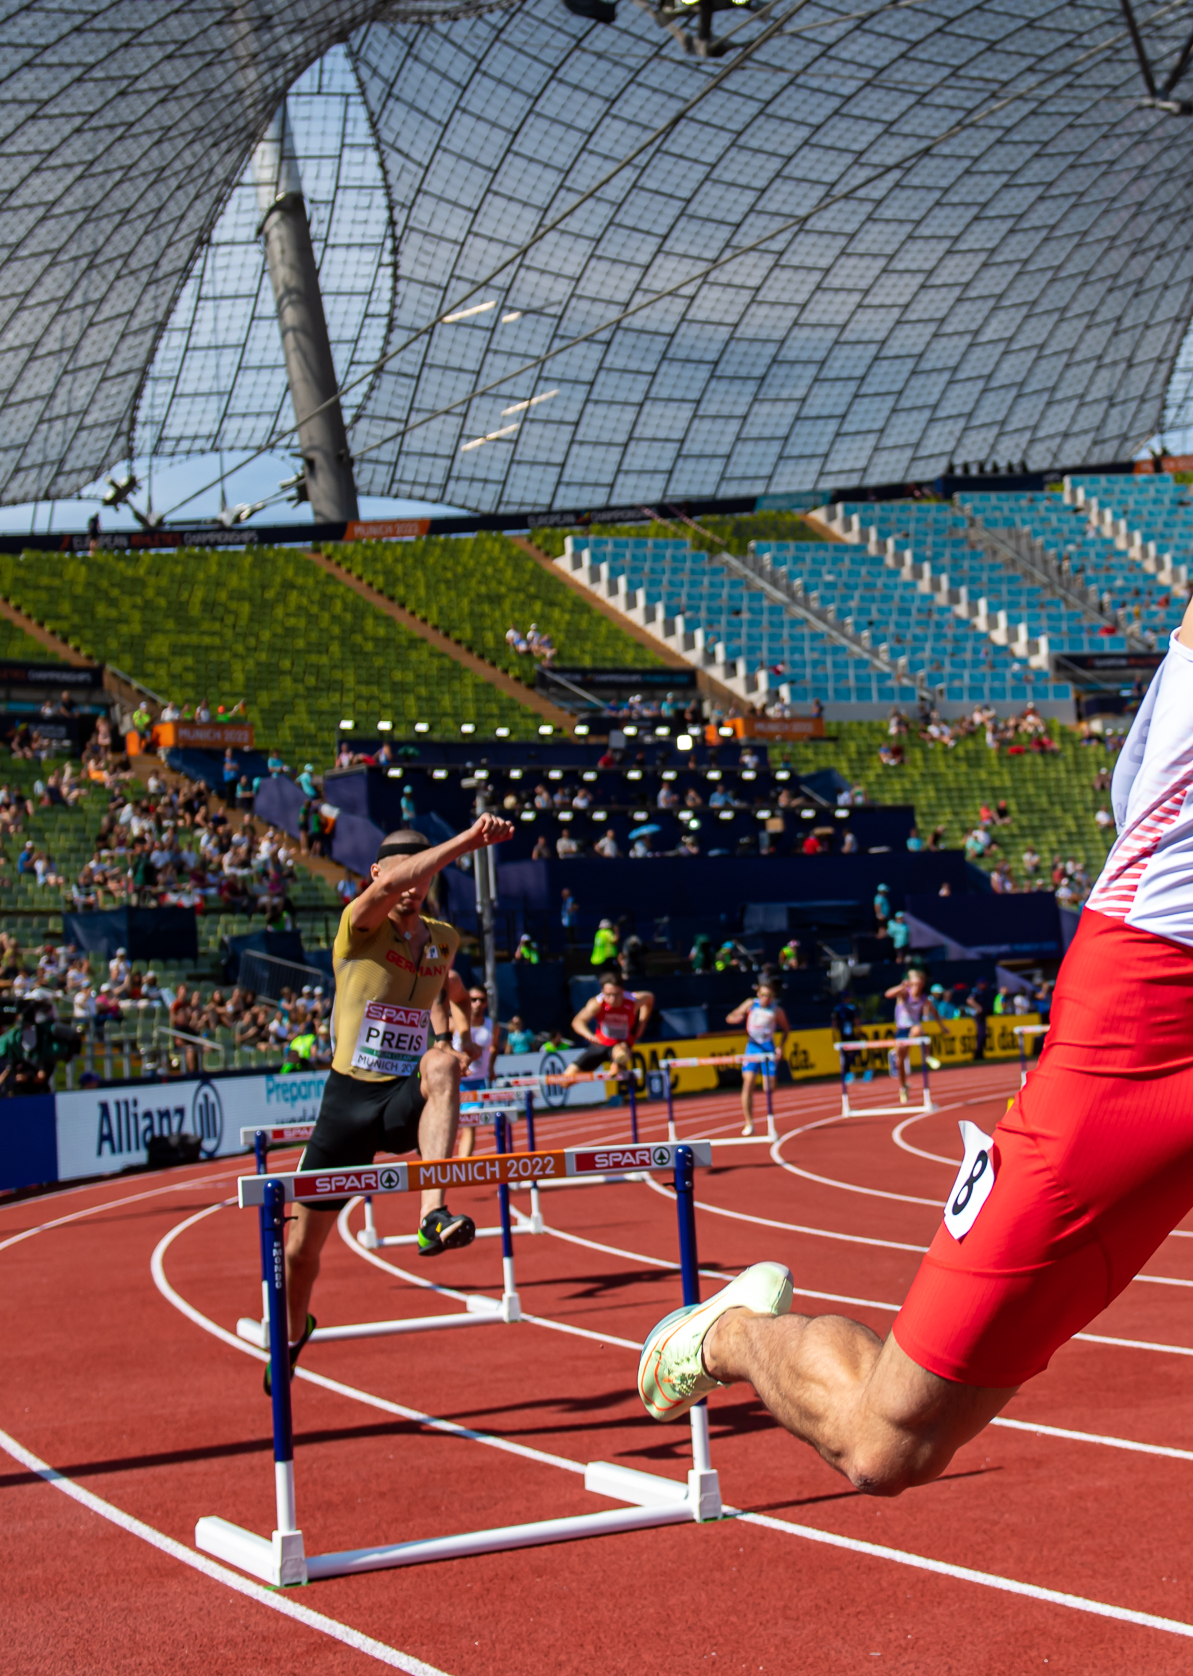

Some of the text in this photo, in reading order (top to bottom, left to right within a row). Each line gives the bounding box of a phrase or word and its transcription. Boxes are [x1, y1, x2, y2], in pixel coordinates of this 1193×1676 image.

[178, 727, 250, 743] MUNICH 2022
[386, 949, 448, 977] GERMANY
[368, 1005, 419, 1026] SPAR
[365, 1027, 424, 1052] PREIS
[357, 1054, 399, 1072] MUNICH
[96, 1098, 185, 1157] Allianz
[594, 1150, 651, 1168] SPAR
[419, 1156, 556, 1186] MUNICH 2022
[315, 1173, 378, 1193] SPAR
[951, 1149, 990, 1217] 8
